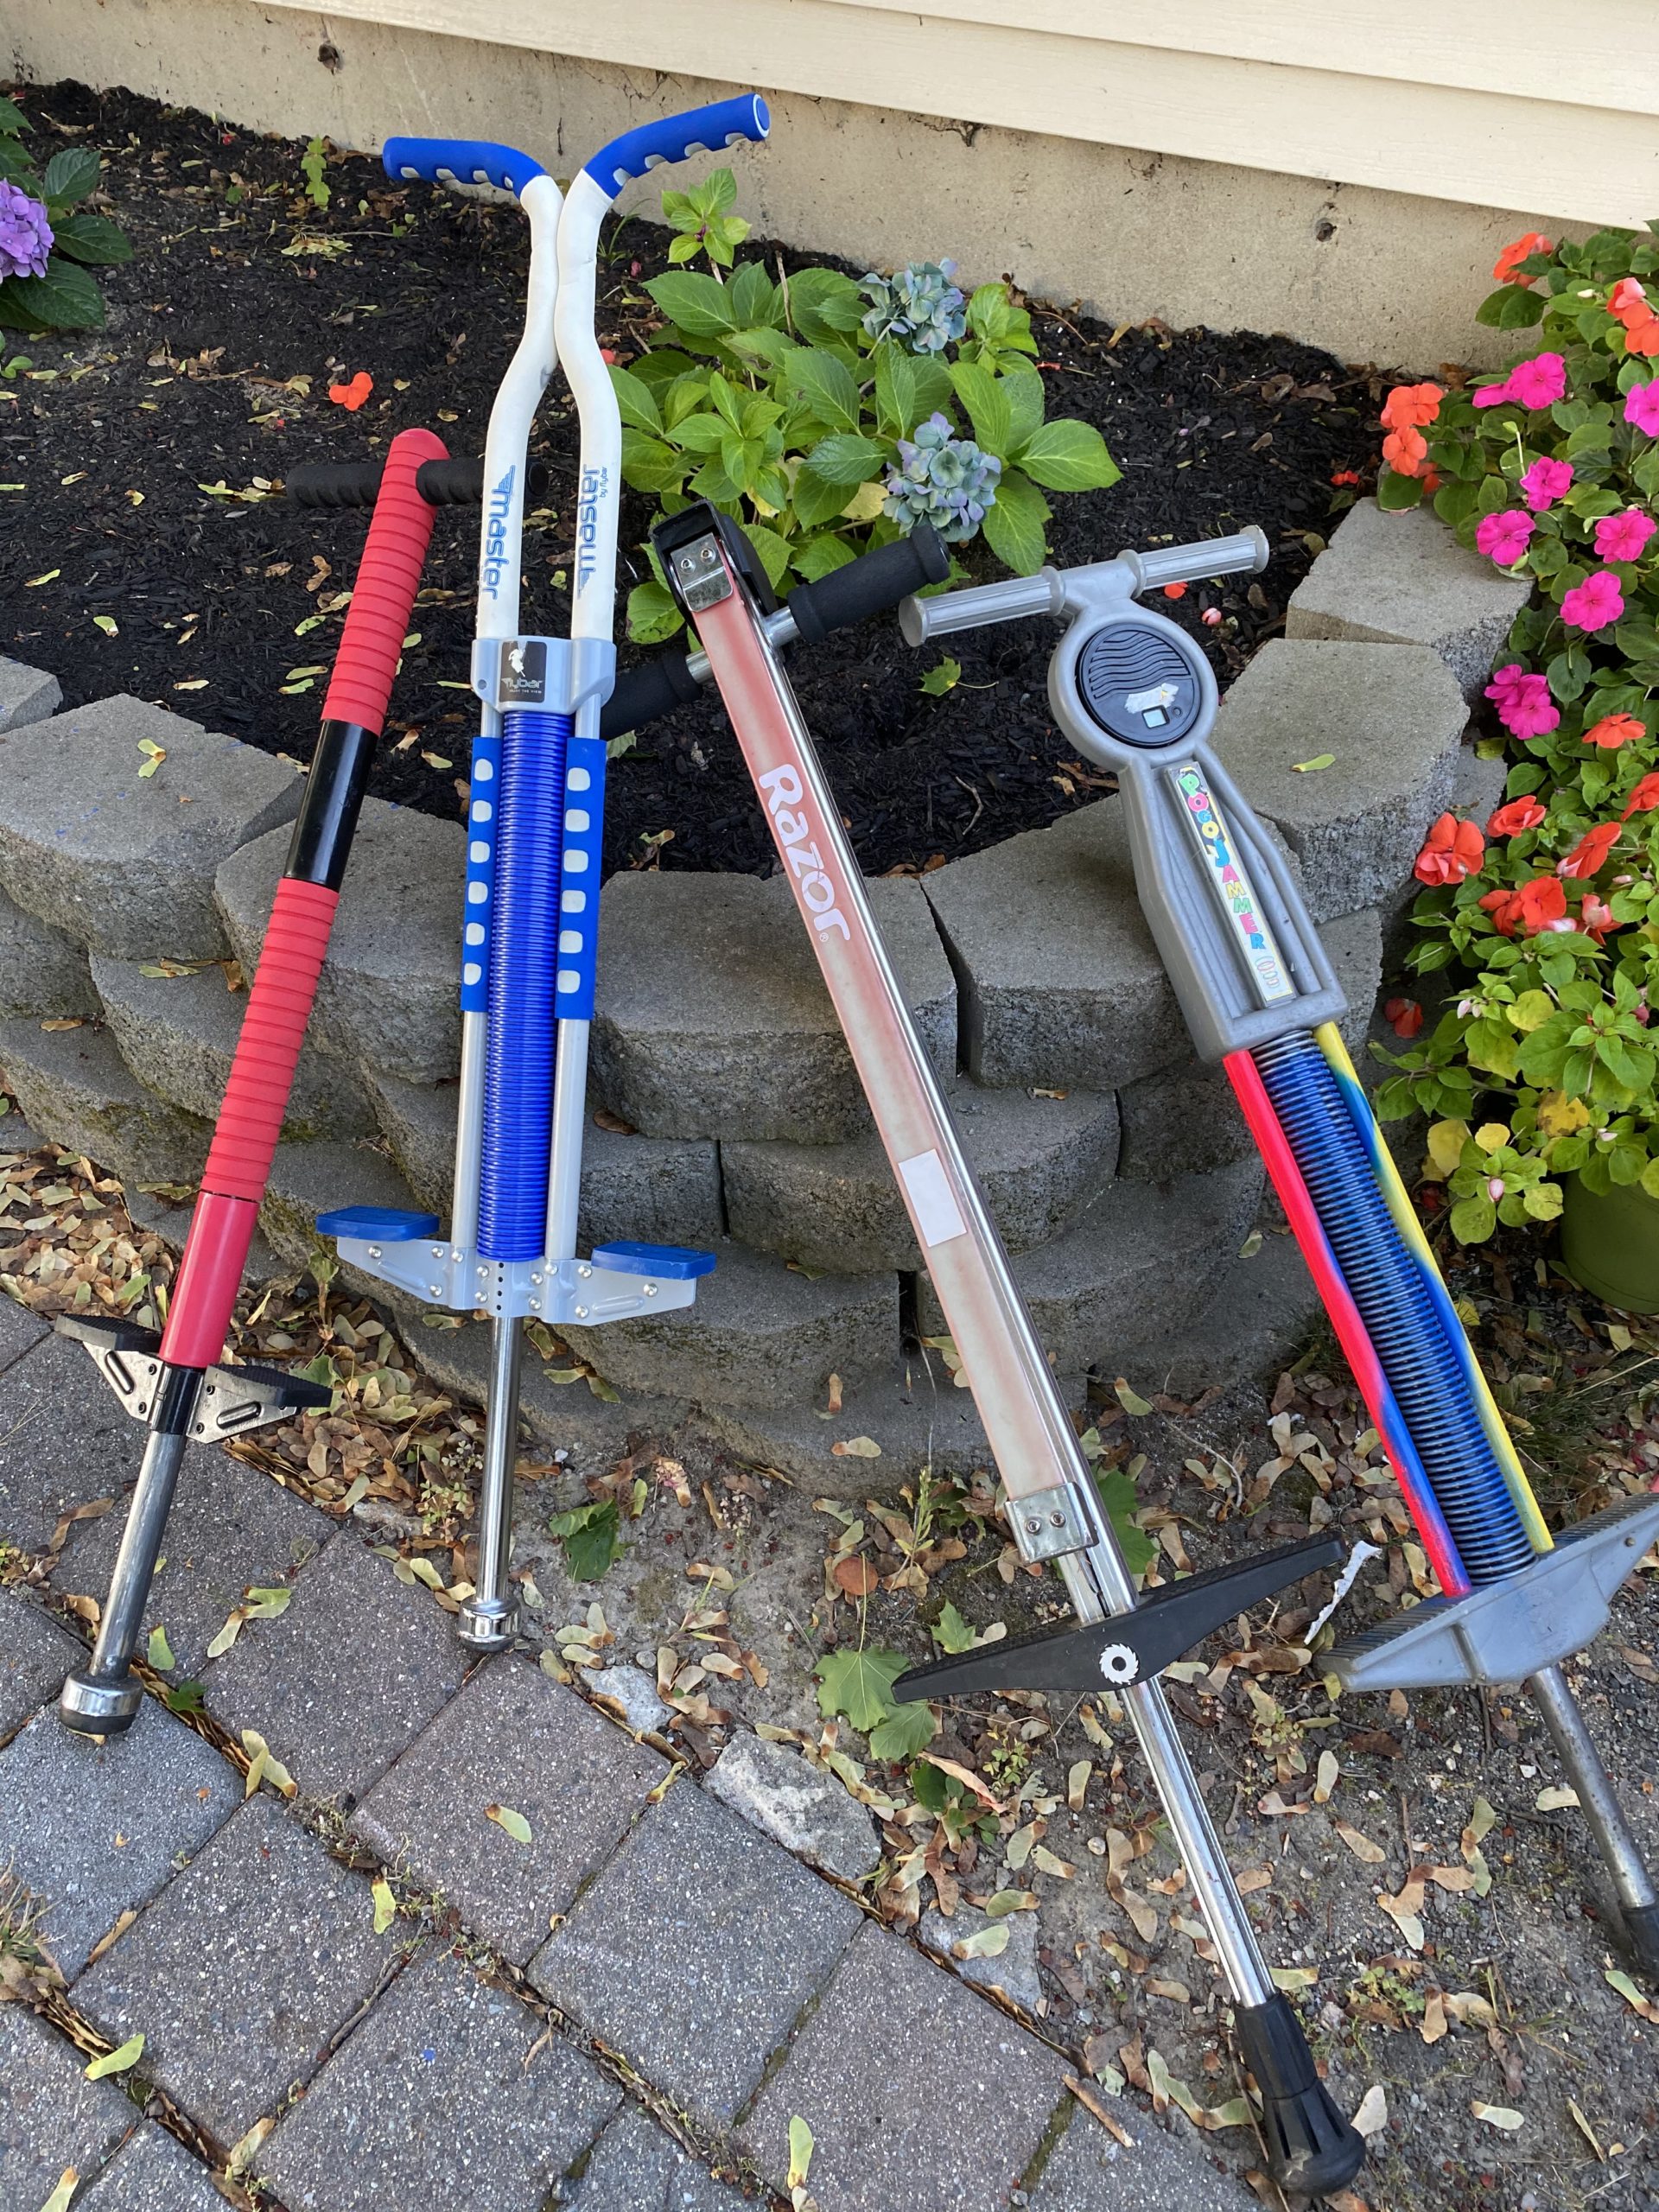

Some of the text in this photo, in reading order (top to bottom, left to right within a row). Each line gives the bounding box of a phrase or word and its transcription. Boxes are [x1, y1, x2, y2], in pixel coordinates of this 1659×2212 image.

[483, 484, 513, 600] master
[576, 464, 600, 572] master
[599, 489, 607, 498] by
